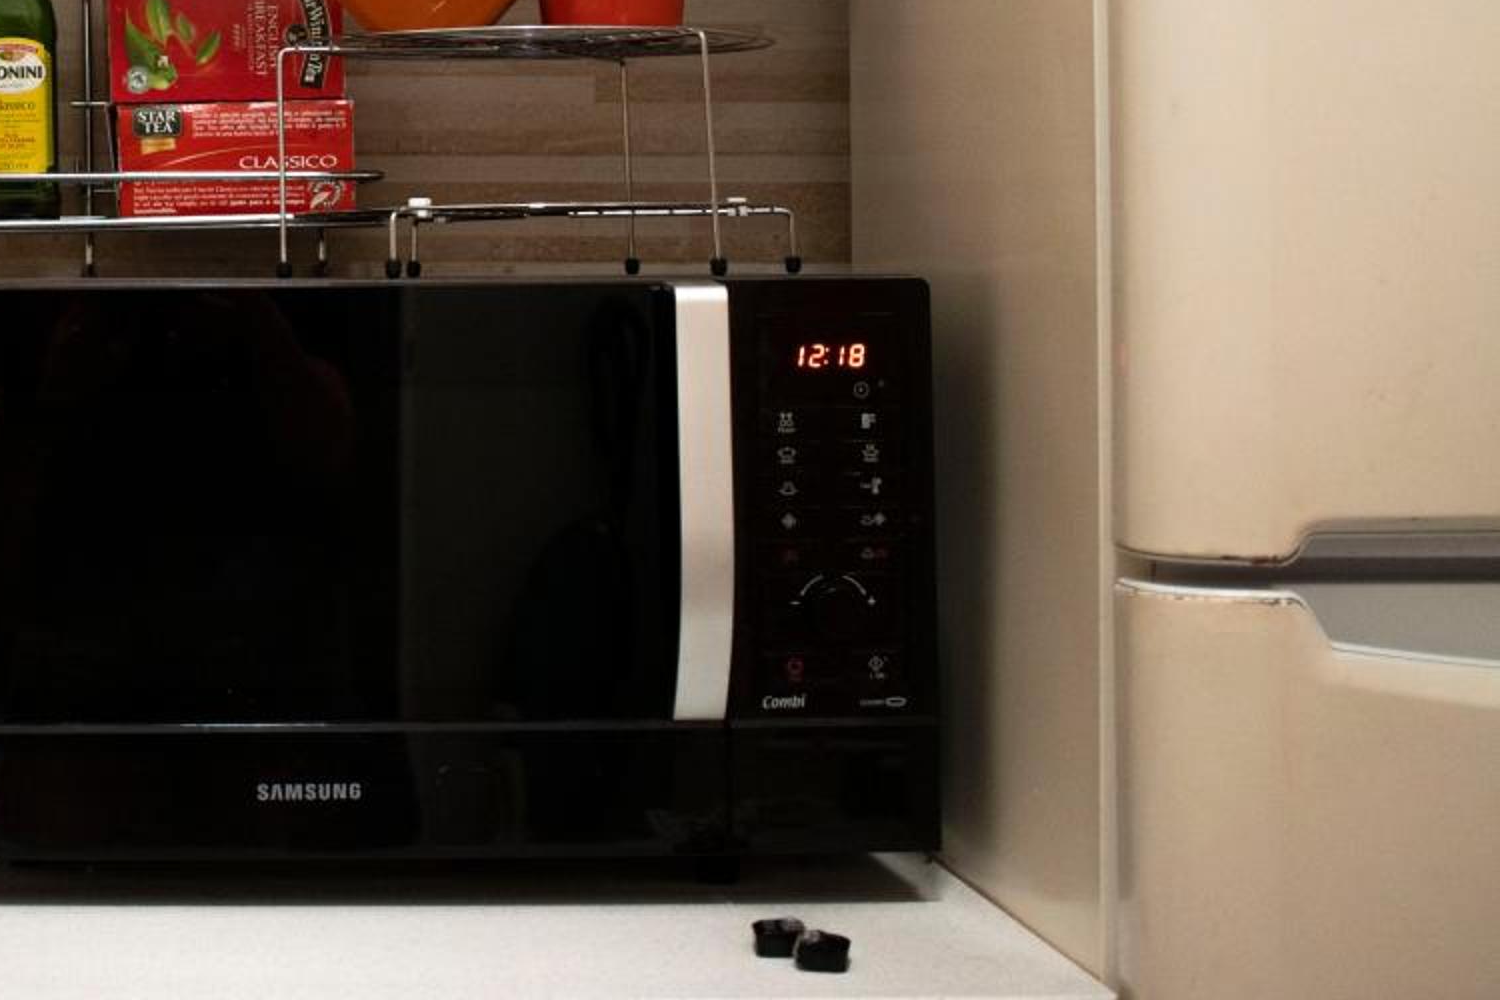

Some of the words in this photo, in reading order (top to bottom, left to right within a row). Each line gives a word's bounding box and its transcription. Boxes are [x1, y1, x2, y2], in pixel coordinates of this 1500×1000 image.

[266, 5, 280, 68] ENGLISH
[138, 111, 176, 123] STAR
[144, 121, 173, 133] TEA
[796, 343, 866, 368] 12:18
[762, 693, 806, 710] Combi
[256, 782, 362, 802] SAMSUNG
